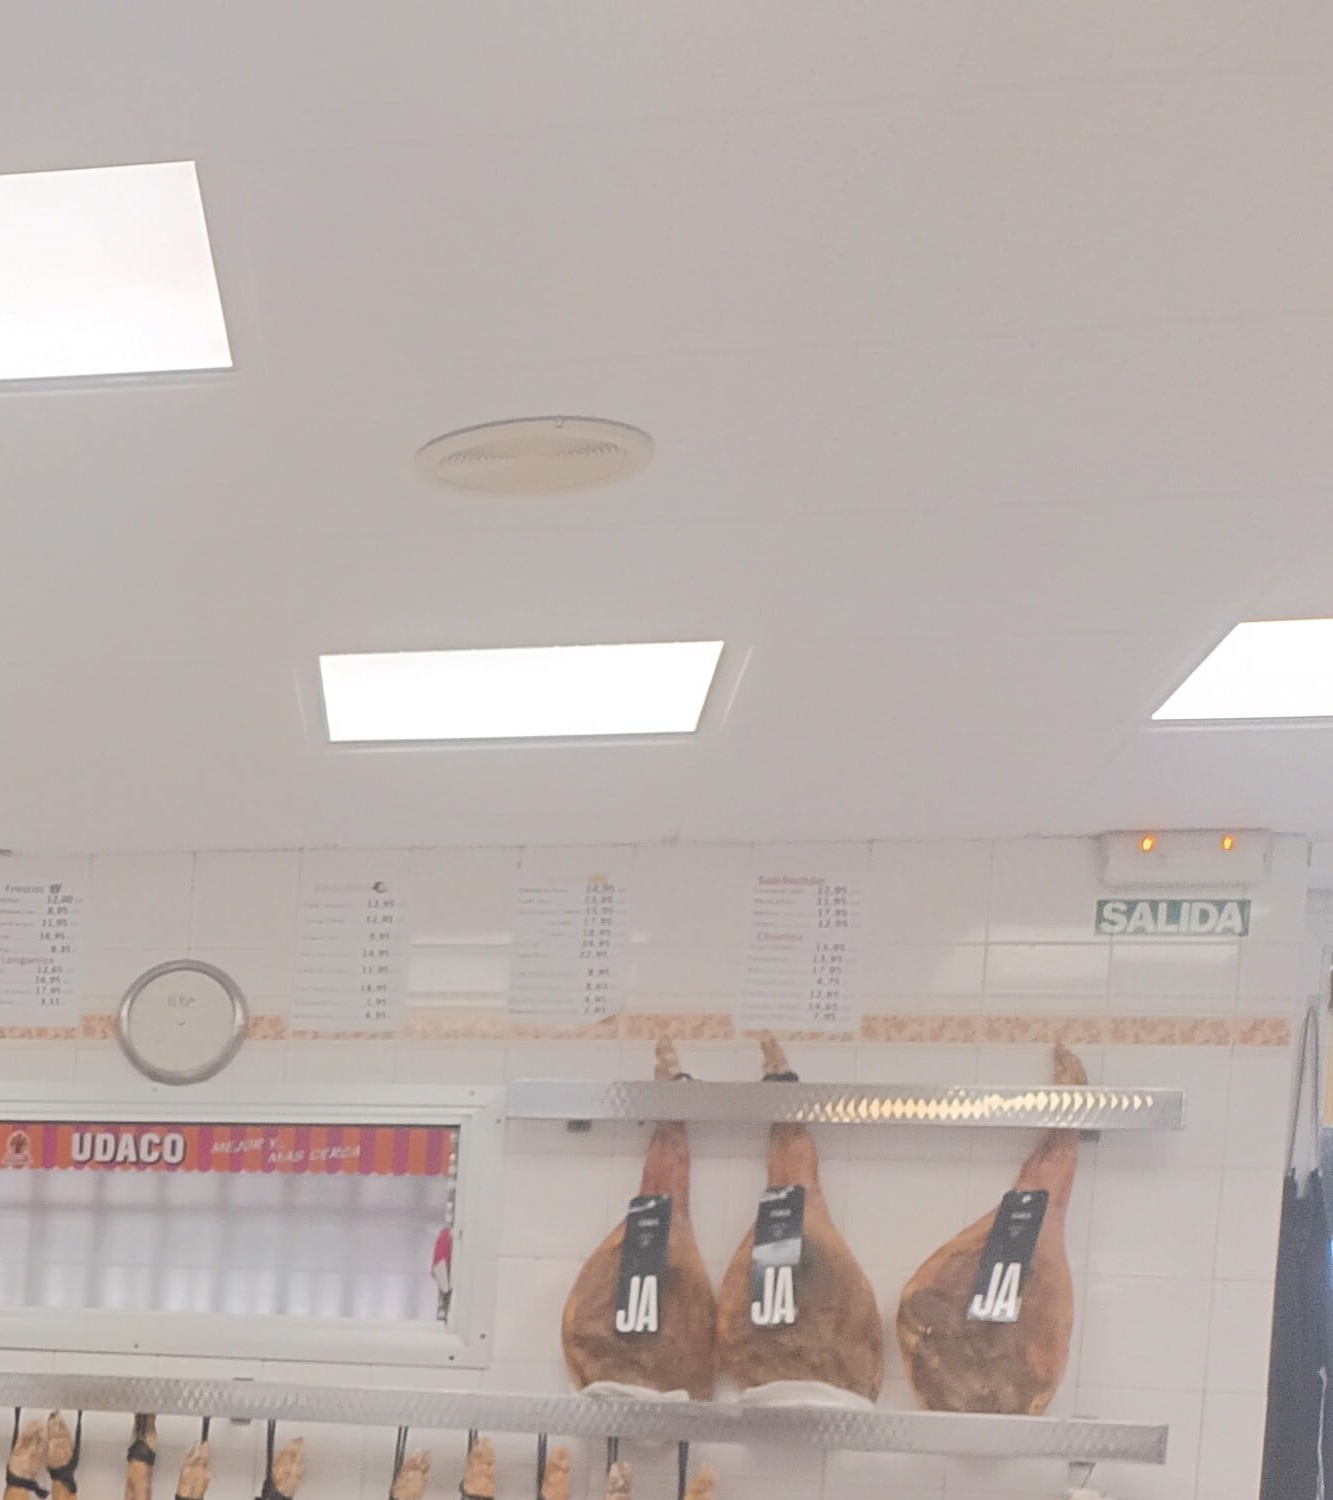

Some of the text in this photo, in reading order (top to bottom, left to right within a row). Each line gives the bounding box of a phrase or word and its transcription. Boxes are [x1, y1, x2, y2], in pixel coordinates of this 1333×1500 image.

[1100, 899, 1247, 935] SALIDA
[71, 1131, 187, 1166] UDACO
[616, 1274, 658, 1333] JA
[751, 1265, 796, 1326] JA
[971, 1261, 1022, 1319] JA
